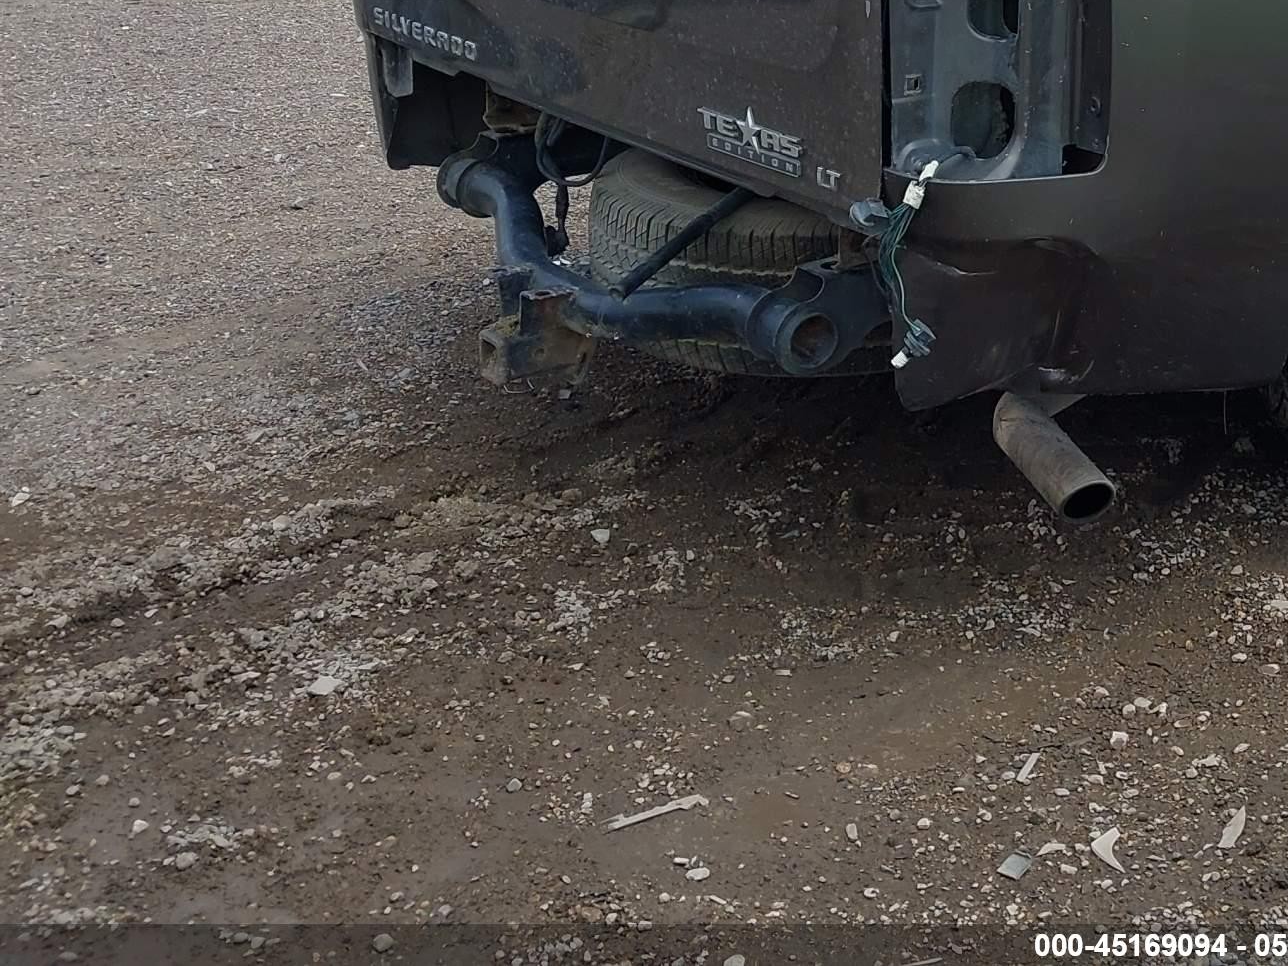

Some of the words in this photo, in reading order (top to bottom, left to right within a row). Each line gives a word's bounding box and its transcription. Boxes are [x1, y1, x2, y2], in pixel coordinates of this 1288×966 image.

[373, 7, 478, 61] SILVERADO
[697, 106, 803, 157] TEXAS
[711, 137, 794, 173] EDITION
[816, 166, 841, 189] LT
